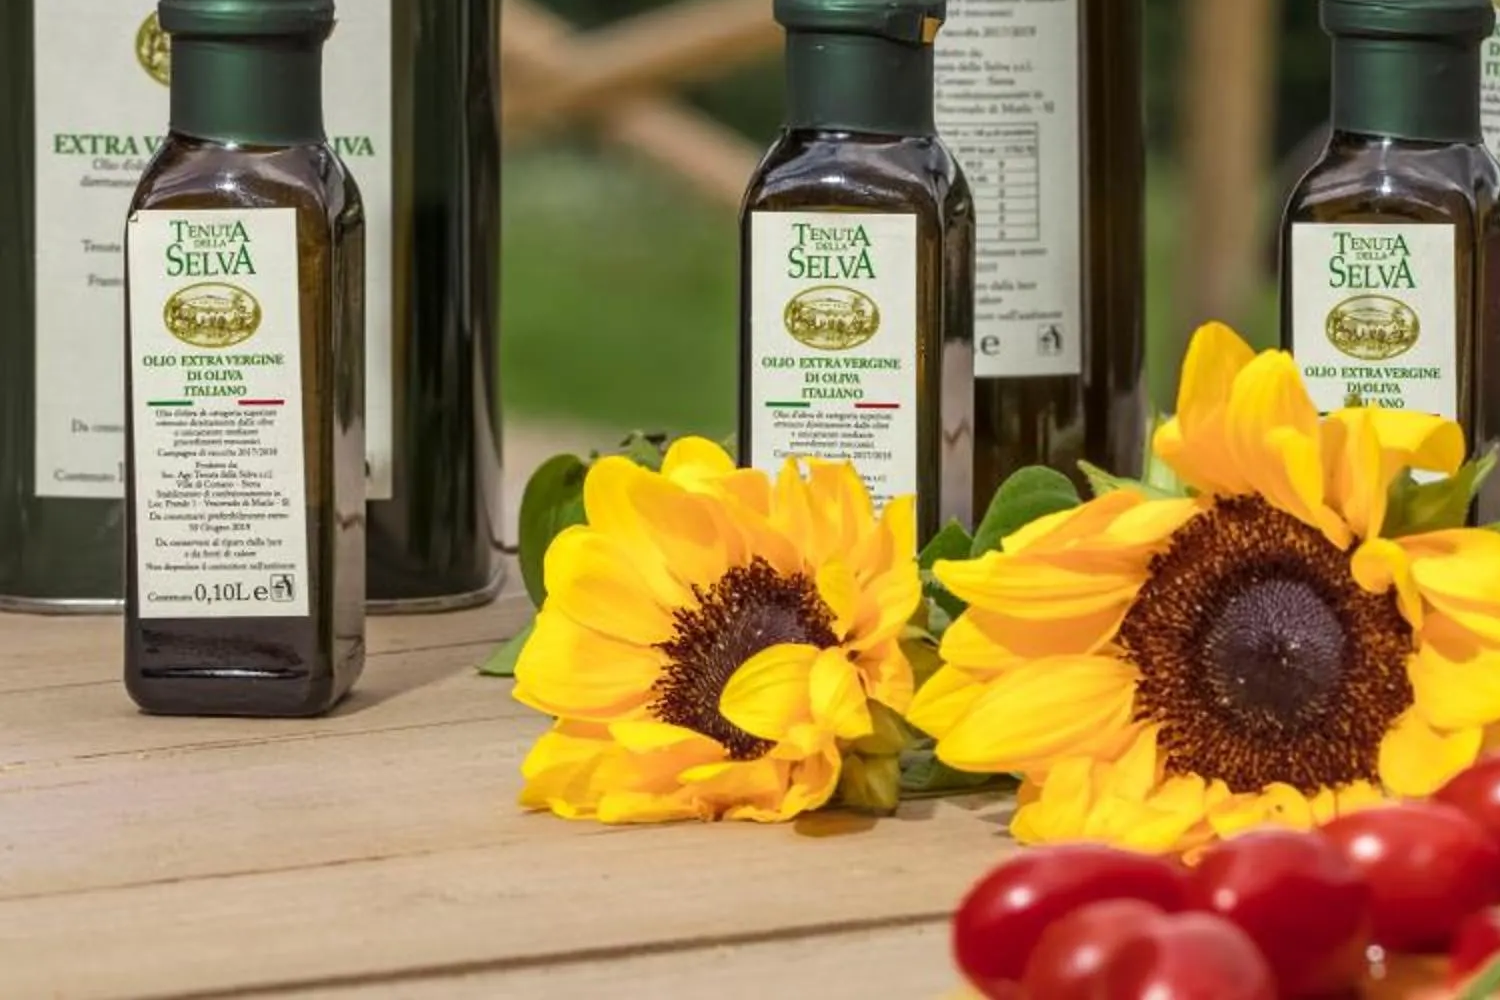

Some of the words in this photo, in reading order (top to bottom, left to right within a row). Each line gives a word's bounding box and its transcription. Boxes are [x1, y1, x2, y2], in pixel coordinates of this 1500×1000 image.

[54, 134, 139, 155] EXTRA
[170, 220, 250, 242] TENUTA
[792, 223, 870, 247] TENUTA
[1333, 231, 1410, 256] TENUTA
[166, 243, 256, 276] SELVA
[788, 247, 876, 279] SELVA
[1357, 252, 1387, 260] DELLA
[1329, 256, 1416, 288] SELVA
[980, 334, 1000, 355] e
[143, 356, 176, 366] OLIO
[181, 356, 224, 366] EXTRA
[225, 355, 284, 365] VERGINE
[762, 358, 795, 368] OLIO
[800, 358, 841, 368] EXTRA
[843, 358, 900, 369] VERGINE
[187, 371, 202, 380] DI
[204, 370, 243, 380] OLIVA
[805, 373, 820, 383] DI
[822, 373, 860, 383] OLIVA
[1305, 367, 1336, 377] OLIO
[1342, 368, 1381, 379] EXTRA
[1384, 368, 1440, 379] VERGINE
[184, 386, 247, 396] ITALIANO
[802, 388, 863, 398] ITALIANO
[1363, 383, 1401, 393] OLIVA
[194, 582, 250, 604] 0,10L
[253, 585, 268, 600] e
